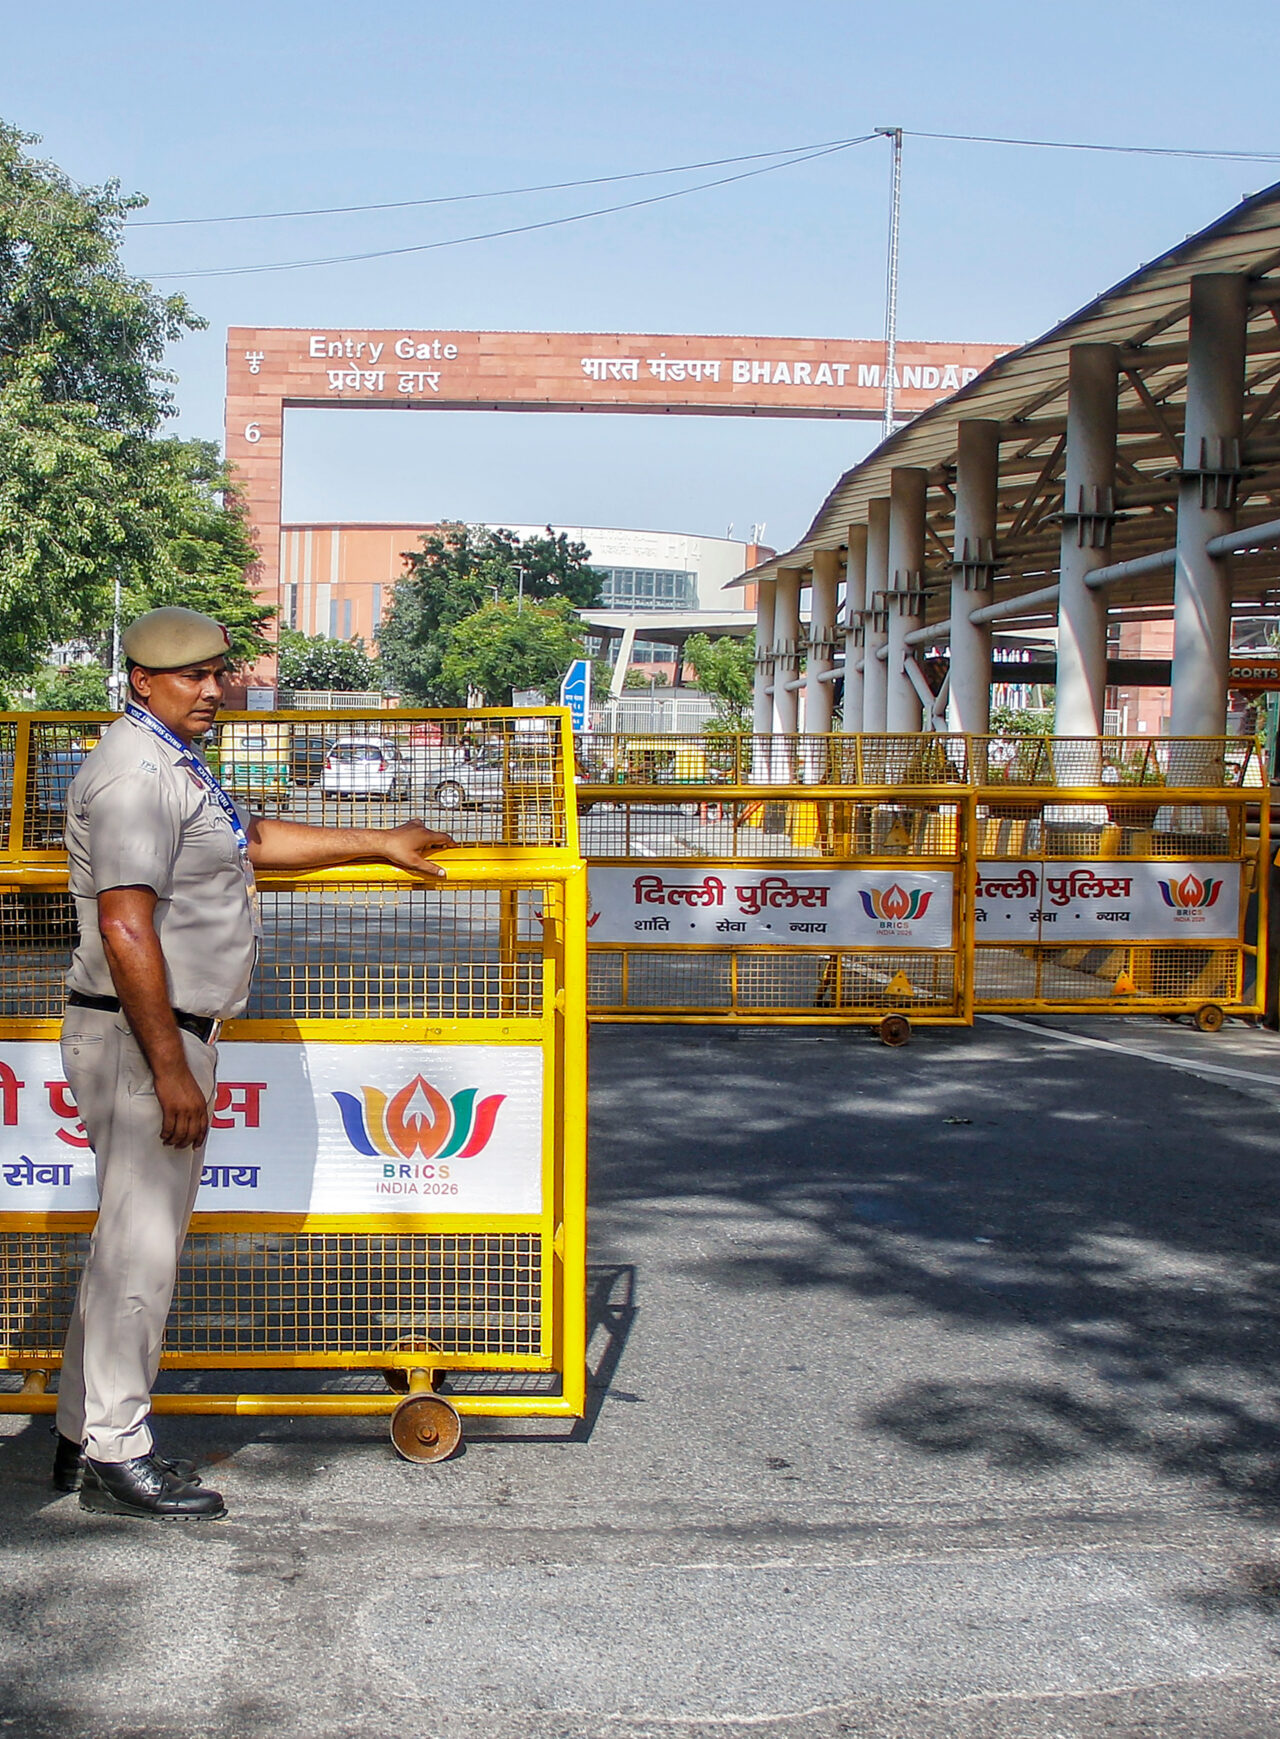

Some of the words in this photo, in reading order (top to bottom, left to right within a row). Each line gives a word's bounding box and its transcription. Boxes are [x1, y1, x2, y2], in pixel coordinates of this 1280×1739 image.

[309, 336, 385, 364] Entry
[394, 337, 459, 361] Gate
[326, 362, 387, 392] प्रवेश
[397, 371, 442, 393] द्वार
[580, 357, 641, 382] भारत
[646, 352, 721, 384] मंडपम
[732, 359, 851, 387] BHARAT
[244, 421, 262, 444] 6
[1228, 666, 1279, 679] CORTS
[632, 875, 727, 907] दिल्ली
[735, 877, 830, 916] पुलिस
[1046, 869, 1134, 906] पुलिस
[634, 916, 671, 931] शांति
[716, 918, 747, 932] सेवा
[789, 922, 827, 934] न्याय
[879, 921, 909, 929] BRICS
[1096, 911, 1130, 923] न्याय
[2, 1154, 74, 1187] सेवा
[382, 1163, 451, 1180] BRICS
[375, 1182, 419, 1195] INDIA
[422, 1182, 459, 1196] 2026
